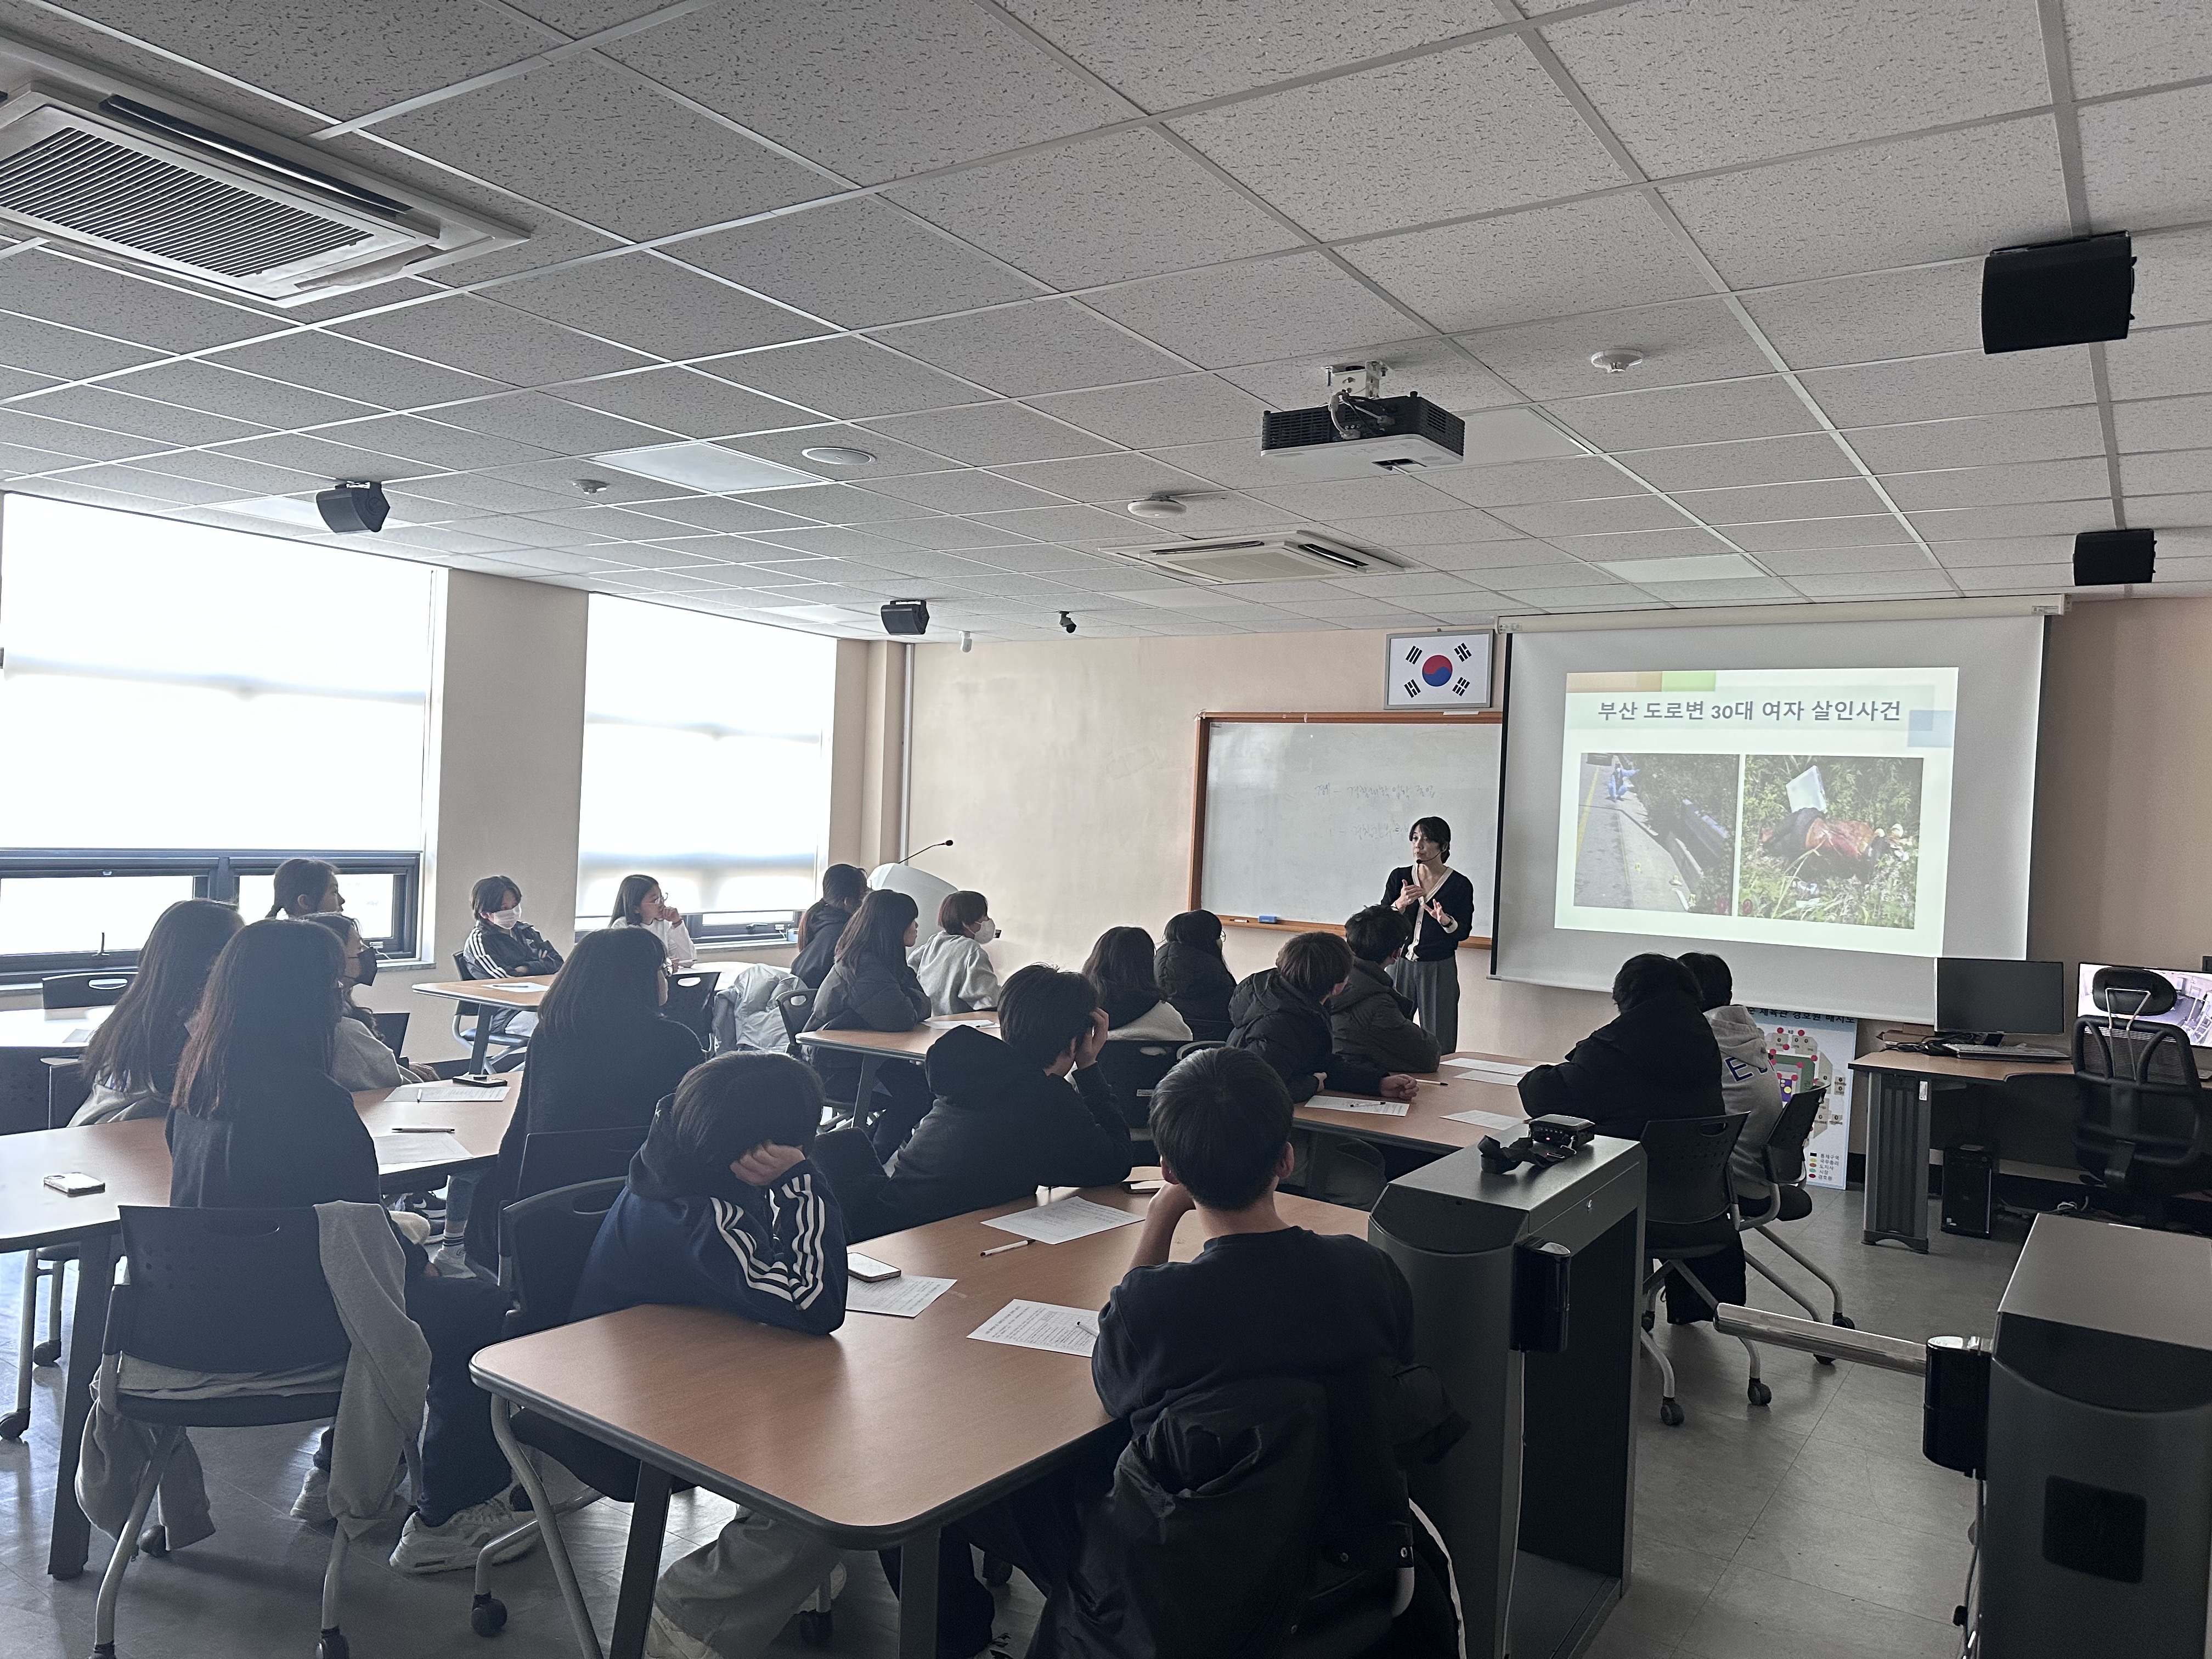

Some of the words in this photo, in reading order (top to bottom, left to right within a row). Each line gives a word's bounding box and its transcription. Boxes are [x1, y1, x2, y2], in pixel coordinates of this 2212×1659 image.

[1598, 702, 1638, 721] 부산
[1643, 701, 1704, 721] 도로변
[1711, 701, 1754, 721] 30대
[1762, 701, 1804, 721] 여자
[1811, 701, 1901, 721] 살인사건
